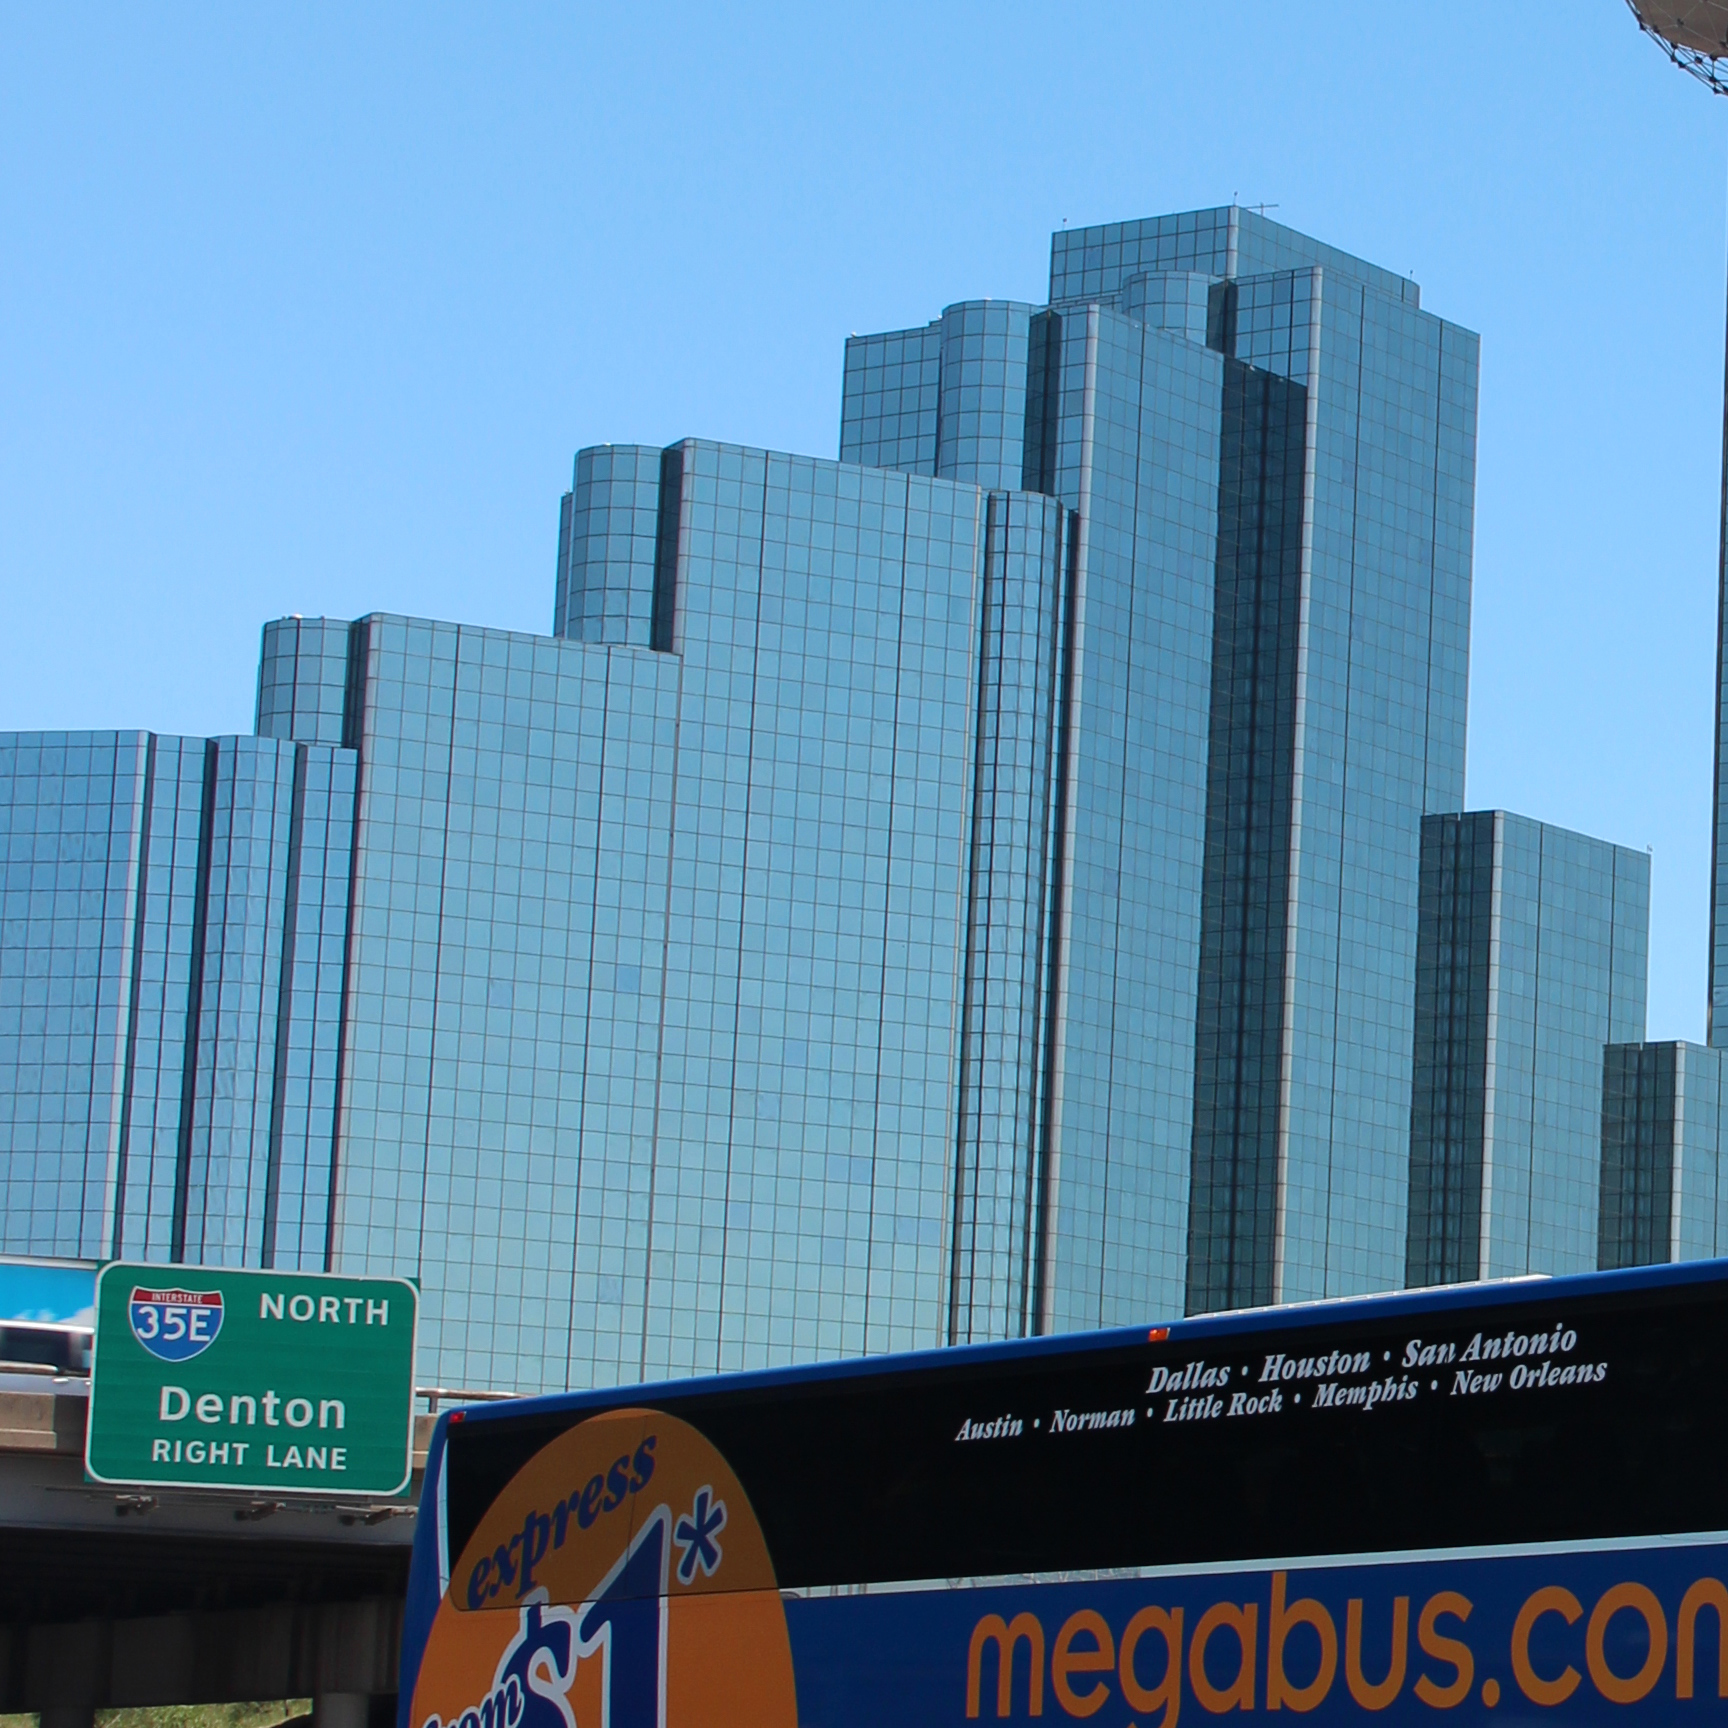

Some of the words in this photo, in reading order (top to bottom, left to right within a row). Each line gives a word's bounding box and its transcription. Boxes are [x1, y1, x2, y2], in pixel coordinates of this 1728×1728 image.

[151, 1293, 203, 1304] INTERSTATE
[259, 1293, 389, 1325] NORTH
[137, 1305, 211, 1342] 35E
[1146, 1361, 1231, 1394] Dallas
[1258, 1350, 1371, 1382] Houston
[1402, 1339, 1455, 1368] San
[1459, 1323, 1577, 1362] Antonio
[158, 1385, 346, 1429] Denton
[955, 1413, 1023, 1441] Austin
[1050, 1407, 1136, 1433] Norman
[1163, 1394, 1223, 1422] Little
[1227, 1388, 1283, 1417] Rock
[1312, 1375, 1418, 1410] Memphis
[1450, 1370, 1503, 1396] New
[1509, 1361, 1608, 1390] Orleans
[152, 1439, 250, 1465] RIGHT
[266, 1445, 347, 1470] LANE
[467, 1435, 657, 1610] express
